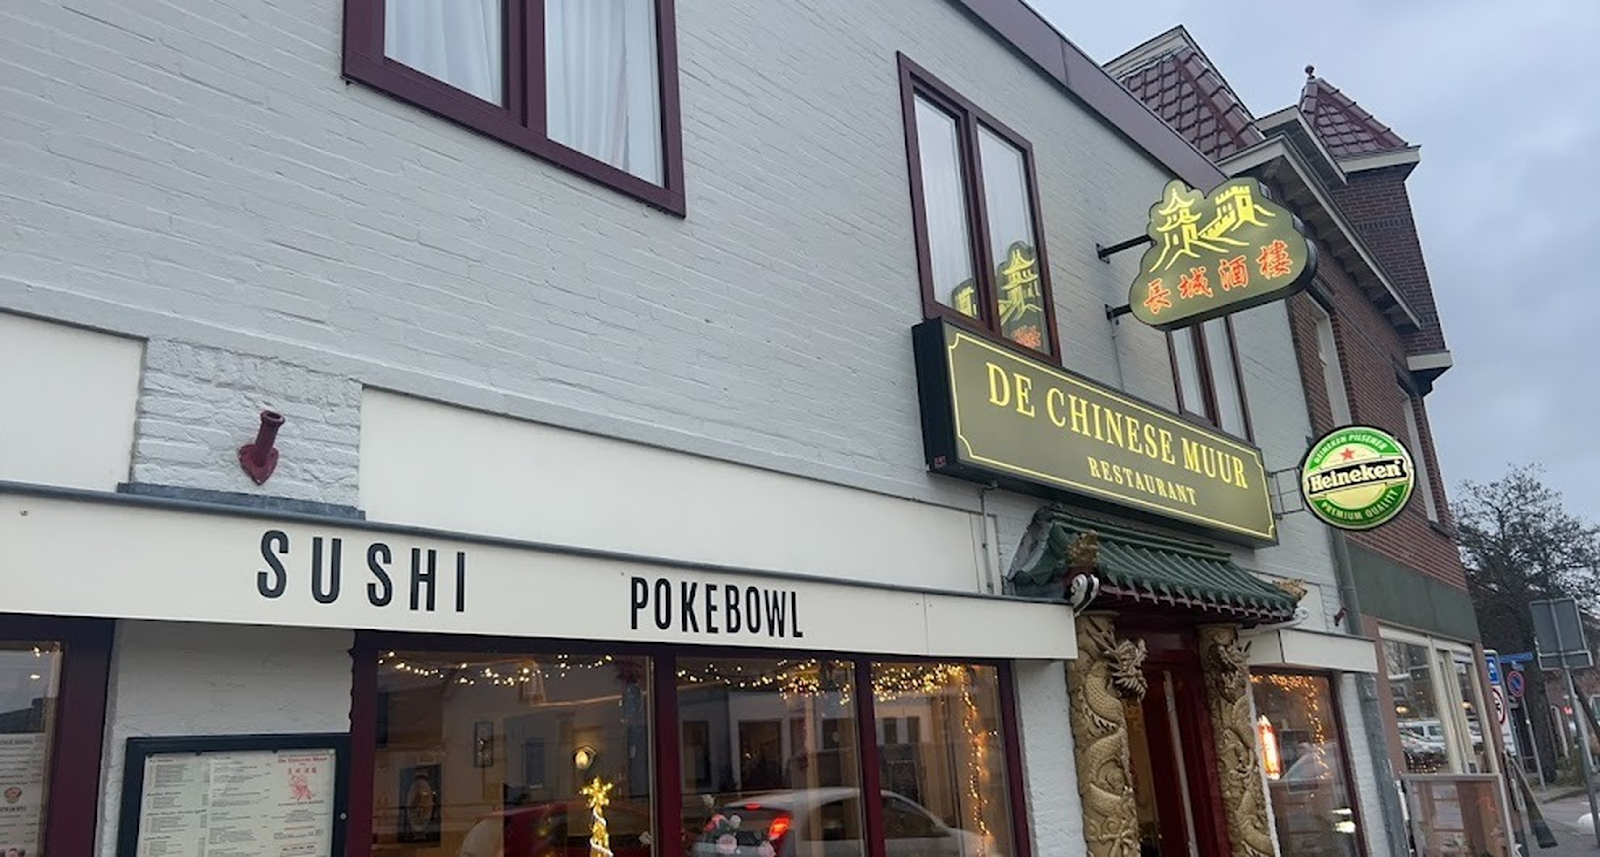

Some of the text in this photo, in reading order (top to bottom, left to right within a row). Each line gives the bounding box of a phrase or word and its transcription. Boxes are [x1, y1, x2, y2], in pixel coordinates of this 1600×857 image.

[1143, 239, 1294, 315] 長城酒樓
[986, 361, 1249, 489] DE CHINESE MUUR
[1314, 434, 1388, 463] HEINEKEN PILSENER
[1087, 456, 1197, 507] RESTAURANT
[1309, 459, 1402, 493] Heineken
[1321, 489, 1399, 520] PREMIUM QUALITY
[257, 530, 466, 612] SUSHI
[629, 576, 804, 638] POKEBOWL
